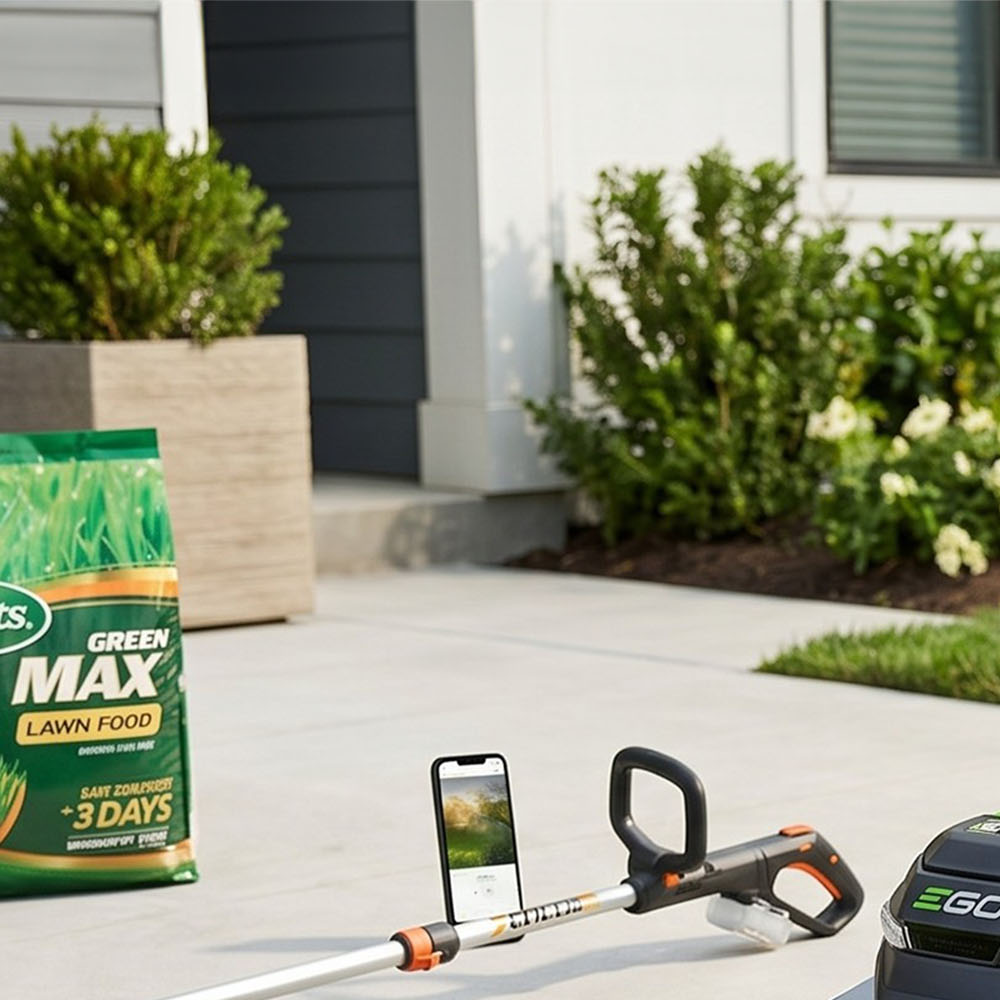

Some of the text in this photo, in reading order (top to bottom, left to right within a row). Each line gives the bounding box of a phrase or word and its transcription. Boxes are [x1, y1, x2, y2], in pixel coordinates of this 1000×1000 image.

[87, 628, 170, 652] GREEN
[11, 651, 163, 706] MAX
[26, 712, 153, 737] LAWN FOOD
[96, 793, 174, 829] DAYS
